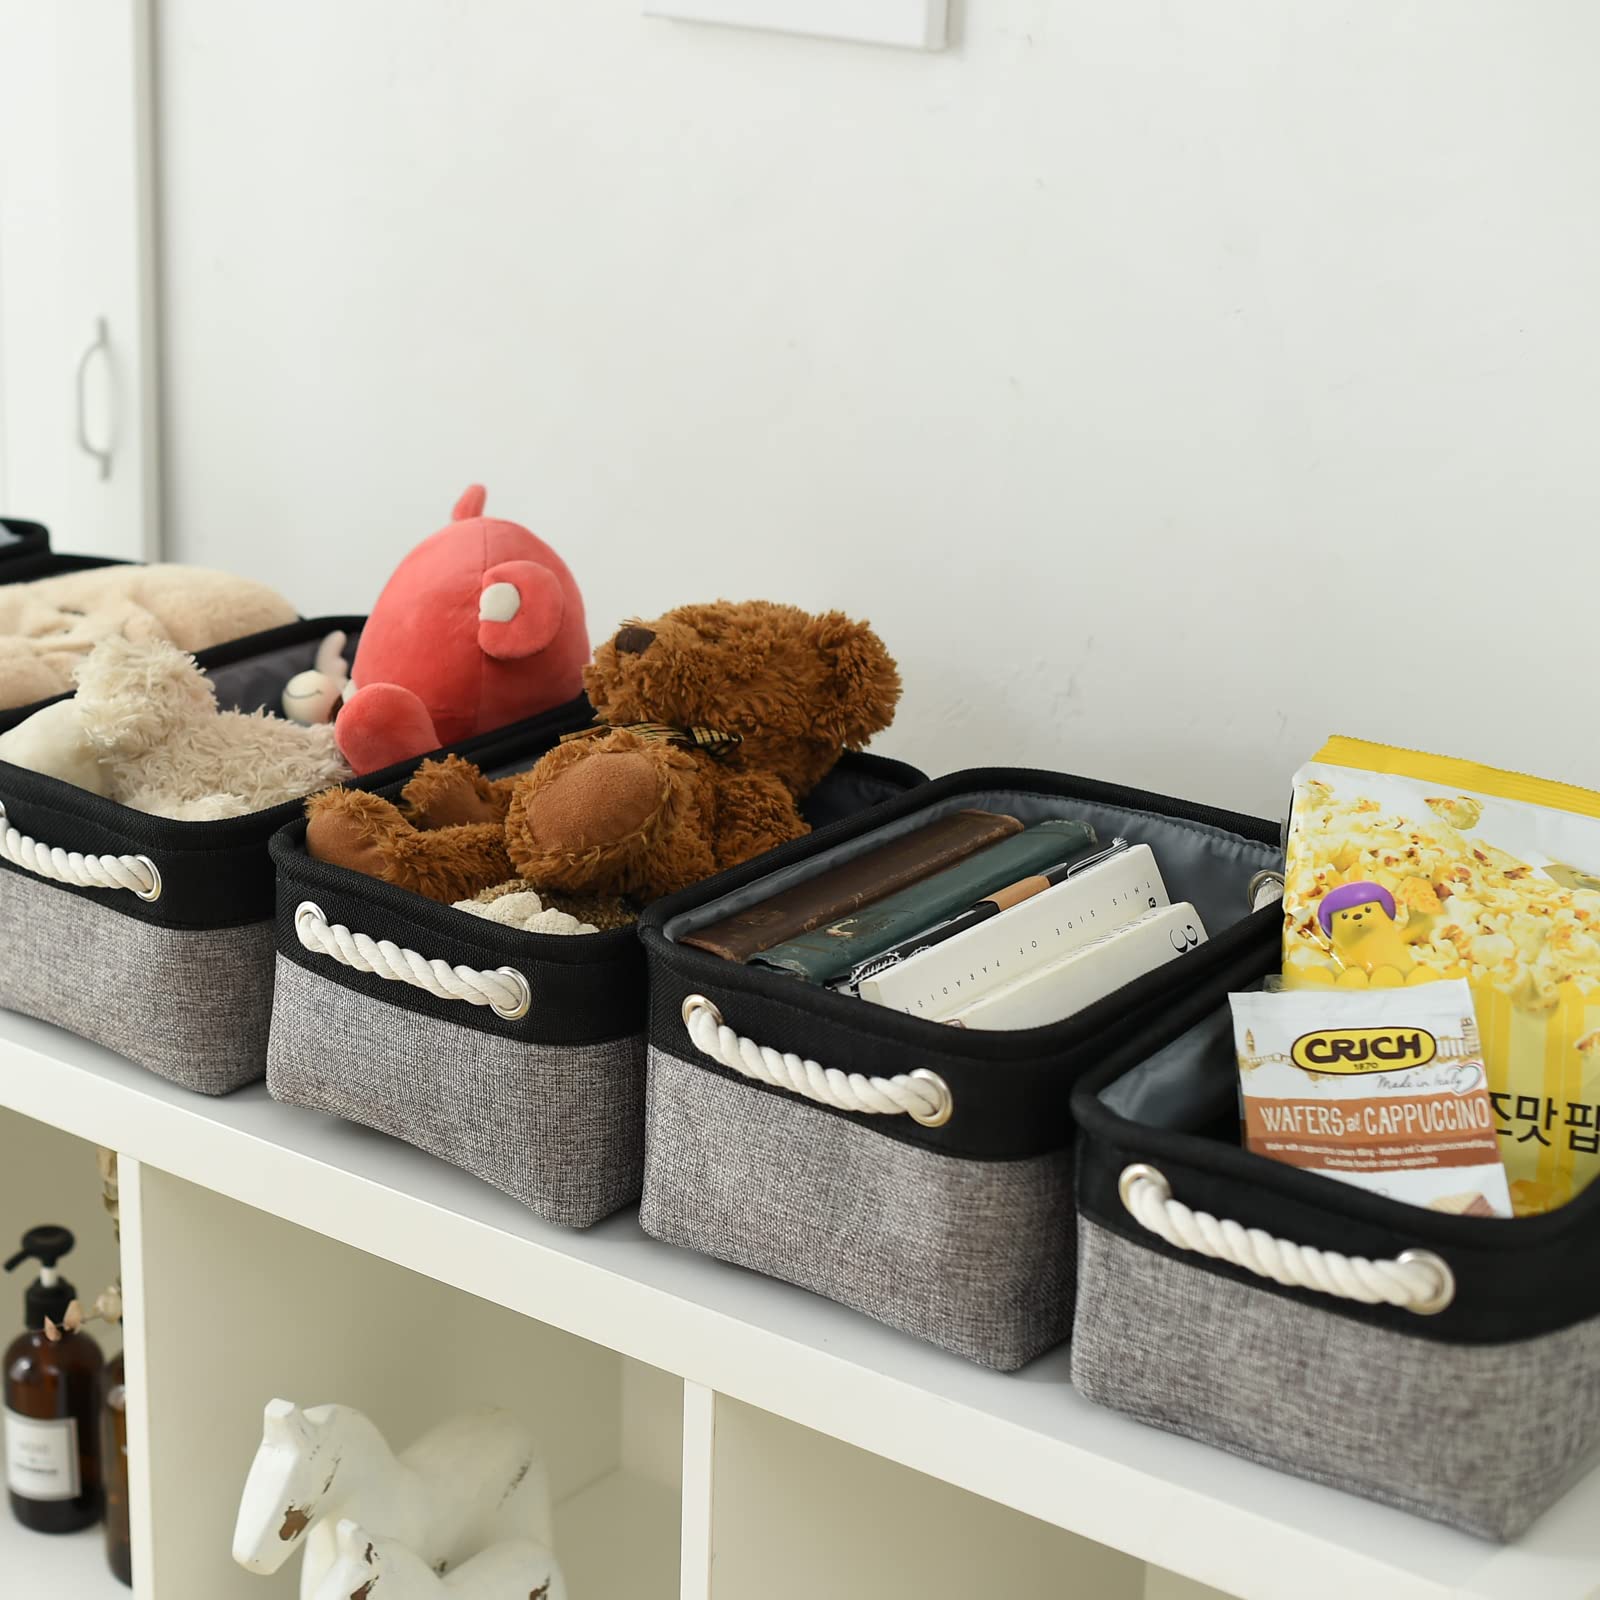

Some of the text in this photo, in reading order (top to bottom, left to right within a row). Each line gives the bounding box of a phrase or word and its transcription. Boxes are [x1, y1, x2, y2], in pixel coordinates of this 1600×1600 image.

[1112, 881, 1151, 906] THIS
[1055, 909, 1096, 936] SIDE
[1019, 940, 1038, 955] OF
[1305, 1033, 1421, 1063] CRICH
[1376, 1074, 1411, 1089] Made
[1416, 1080, 1430, 1088] in
[1259, 1106, 1345, 1137] WAFERS
[1363, 1097, 1491, 1135] CAPPUCCINO
